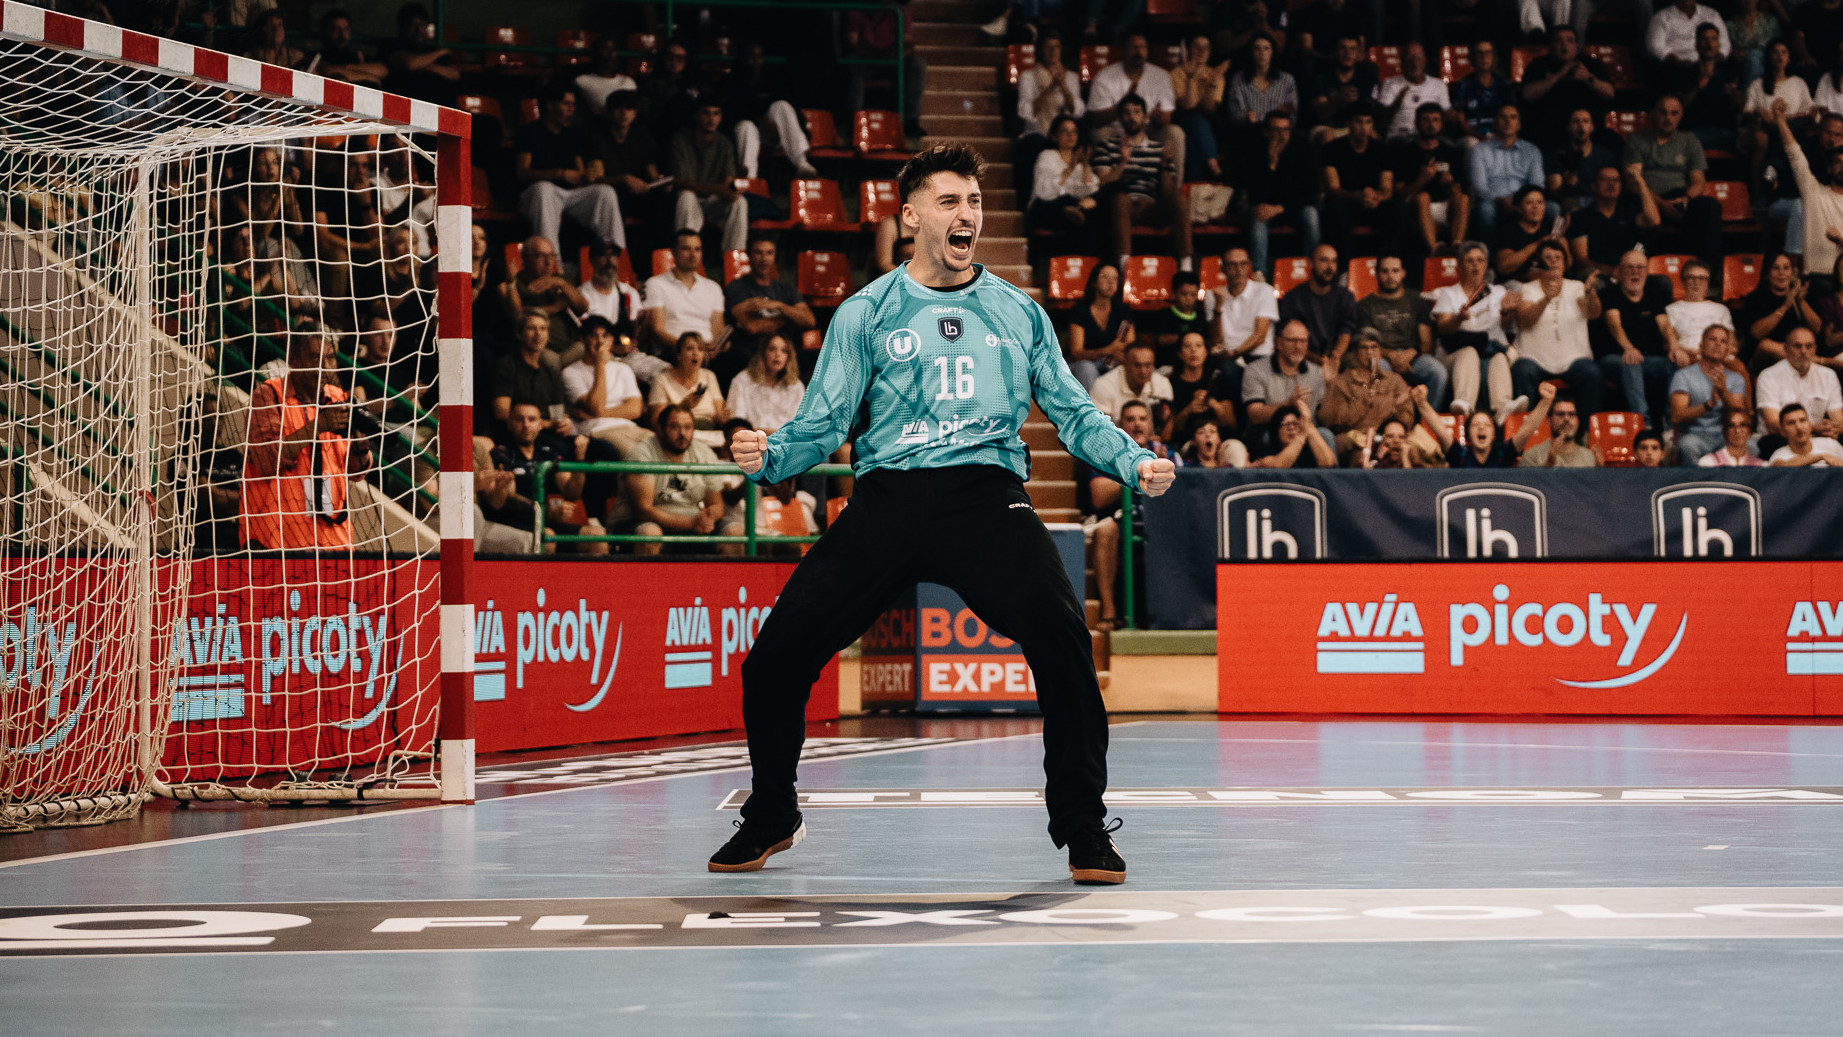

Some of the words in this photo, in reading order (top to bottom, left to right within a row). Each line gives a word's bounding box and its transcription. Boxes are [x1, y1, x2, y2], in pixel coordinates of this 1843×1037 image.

[934, 355, 974, 400] 16
[261, 589, 386, 705] picoty
[516, 587, 610, 689] picoty
[721, 586, 779, 676] pic
[921, 607, 1016, 648] BO
[1450, 583, 1657, 667] picoty
[863, 663, 911, 692] EXPERT
[929, 662, 1037, 692] EXPE
